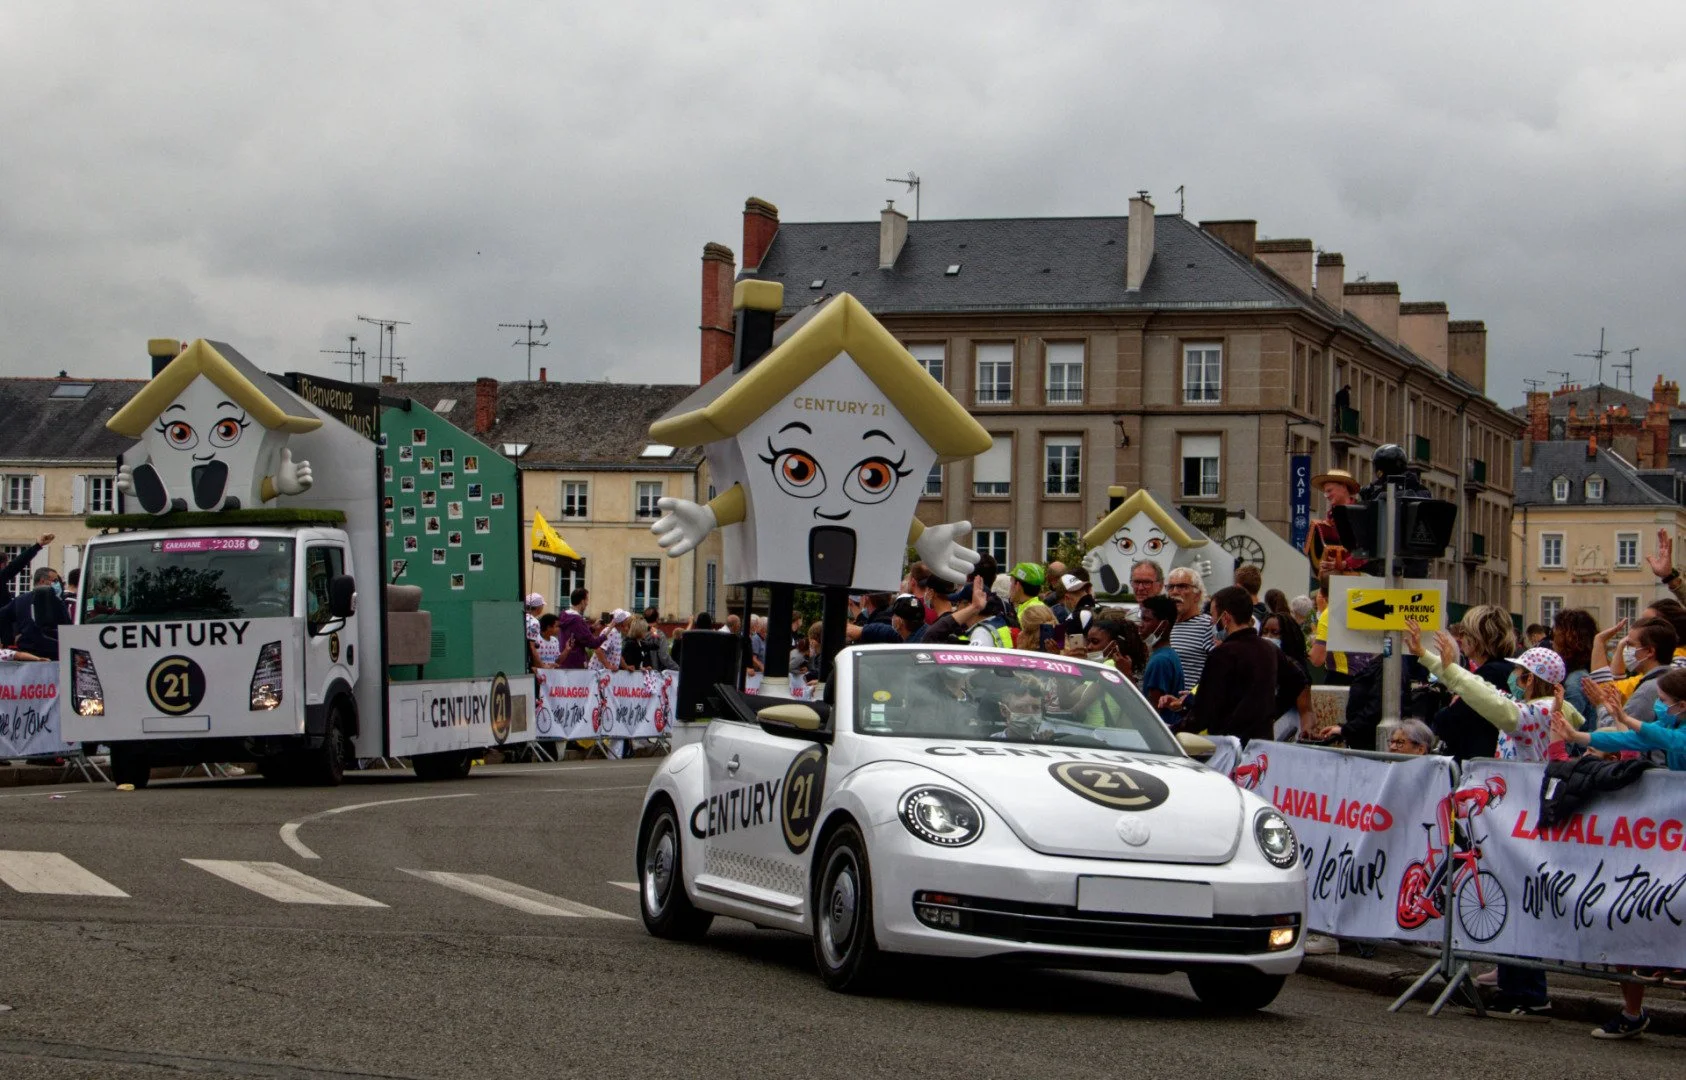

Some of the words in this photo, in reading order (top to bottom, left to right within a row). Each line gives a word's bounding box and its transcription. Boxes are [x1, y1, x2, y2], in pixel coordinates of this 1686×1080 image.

[301, 377, 353, 411] Bienvenue
[793, 397, 868, 414] CENTURY
[872, 404, 885, 416] 21
[1296, 466, 1306, 498] CAP
[165, 541, 201, 550] CARAVANE
[222, 539, 245, 549] 2036
[1399, 604, 1434, 613] PARKING
[99, 621, 250, 650] CENTURY
[939, 654, 1004, 664] CARAVANE
[1043, 660, 1073, 674] 2117
[20, 683, 56, 699] AGGLO
[163, 673, 191, 698] 21
[11, 706, 21, 741] le
[431, 694, 487, 728] CENTURY
[495, 692, 506, 722] 21
[924, 746, 1207, 774] CENTURY
[1081, 769, 1140, 791] 21
[690, 778, 781, 839] CENTURY
[790, 773, 814, 820] 21
[1273, 785, 1331, 823] LAVAL
[1608, 816, 1686, 851] AGG
[1312, 835, 1337, 900] le
[1523, 861, 1577, 920] aime
[1575, 858, 1606, 930] le
